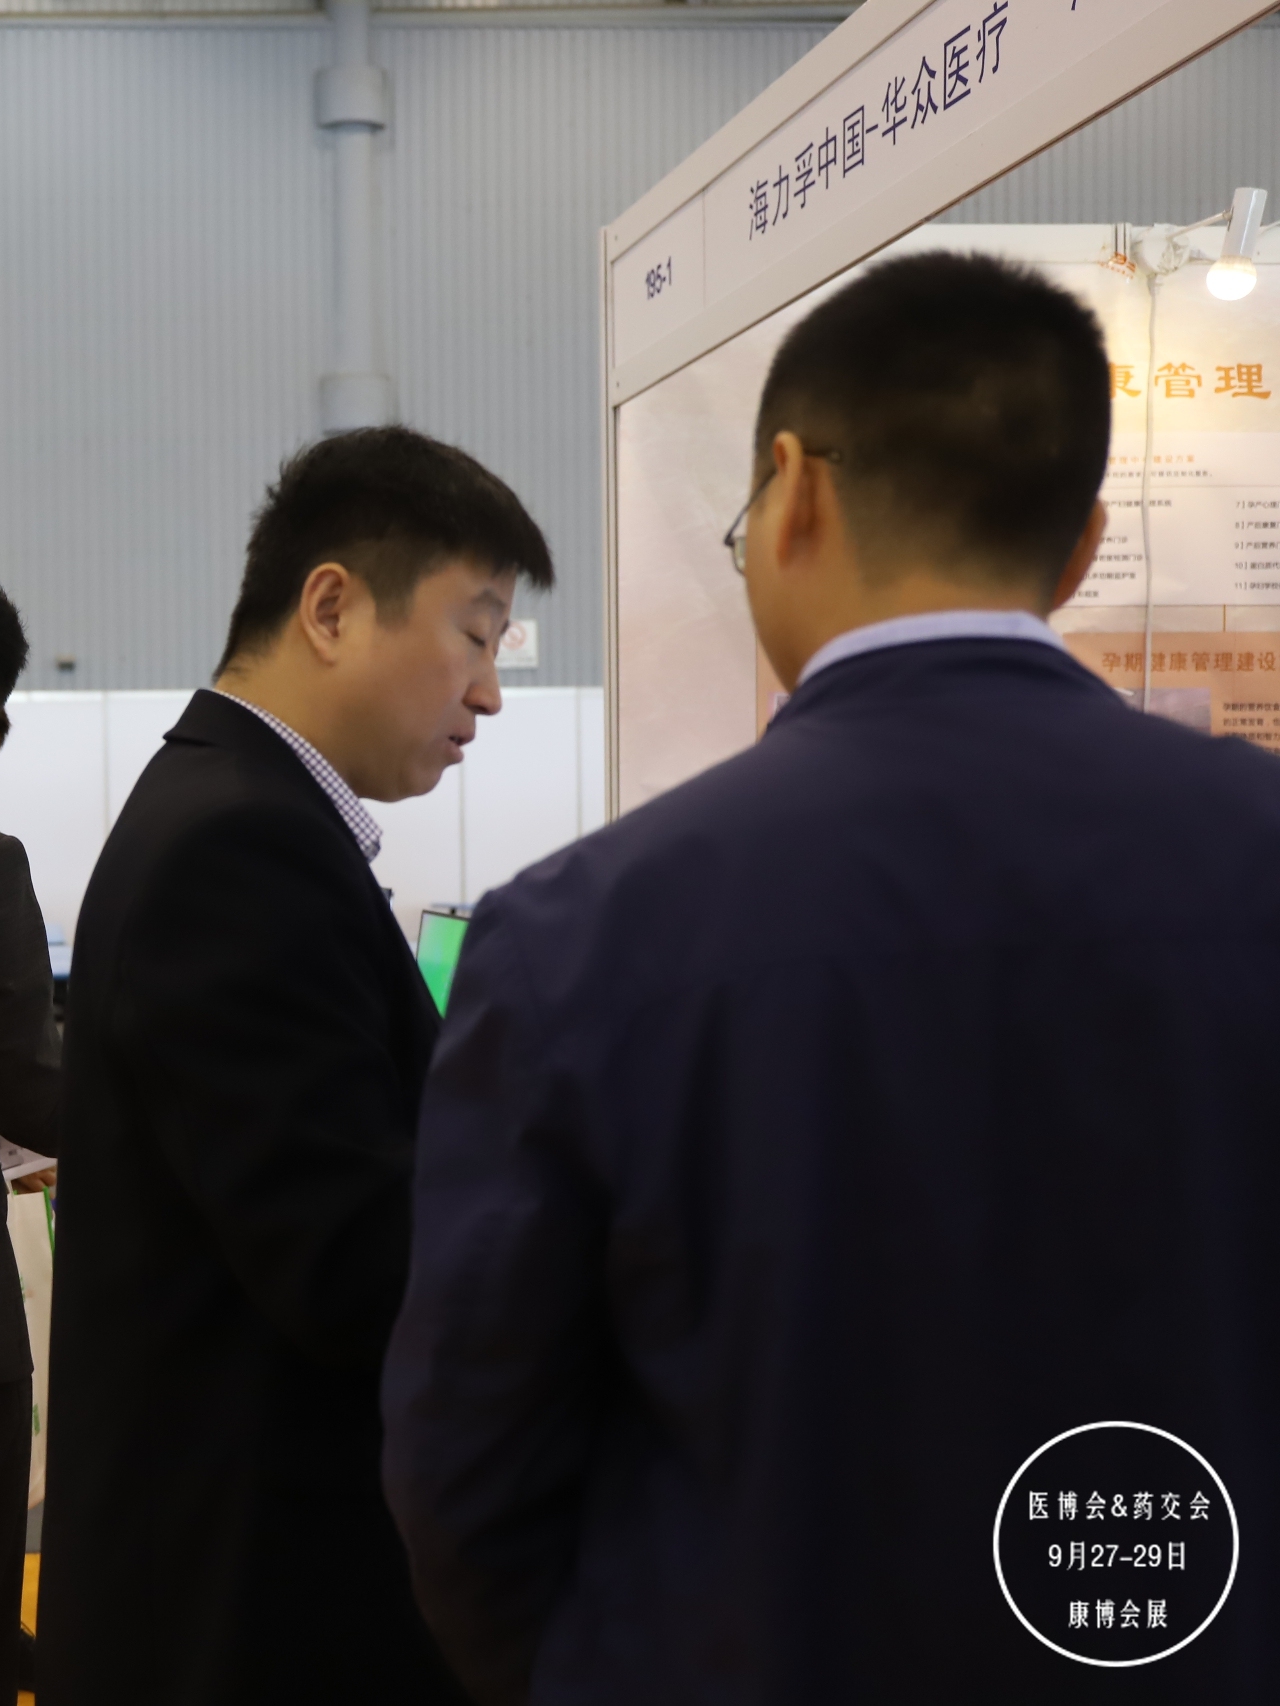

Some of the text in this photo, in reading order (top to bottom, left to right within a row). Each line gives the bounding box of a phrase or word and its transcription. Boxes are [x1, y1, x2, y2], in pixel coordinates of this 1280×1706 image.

[749, 1, 1009, 240] 海力孚中国-华众医疗
[645, 256, 672, 300] 195-1
